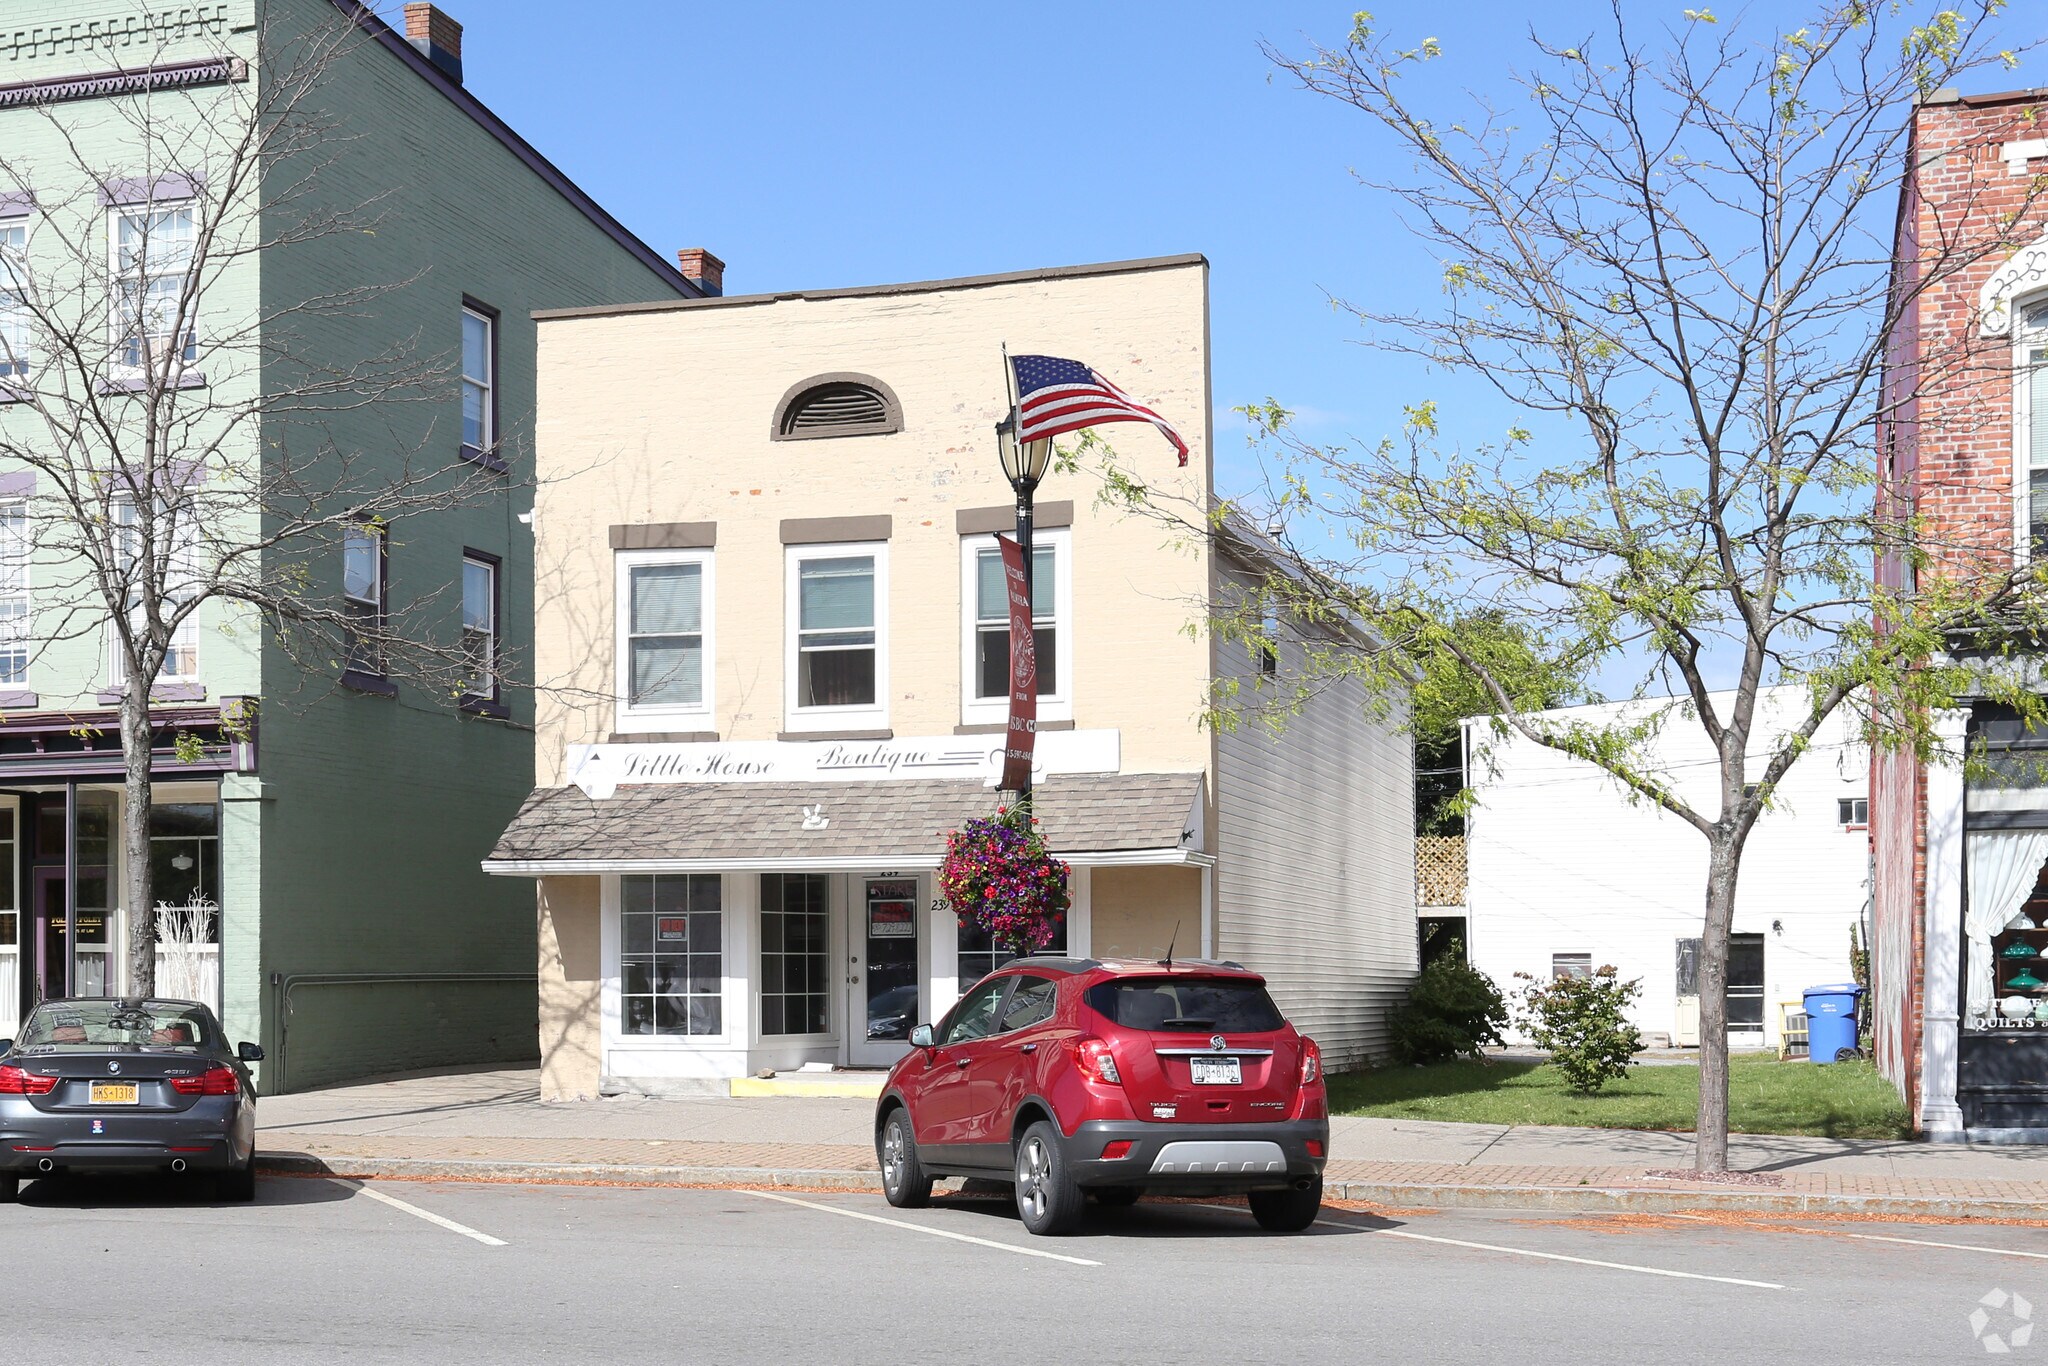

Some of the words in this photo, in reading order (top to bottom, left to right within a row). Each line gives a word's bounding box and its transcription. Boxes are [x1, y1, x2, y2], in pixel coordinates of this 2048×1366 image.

[623, 751, 689, 777] Little
[696, 751, 775, 776] House
[816, 744, 931, 773] Boutique
[1974, 1017, 2035, 1032] QUILTS
